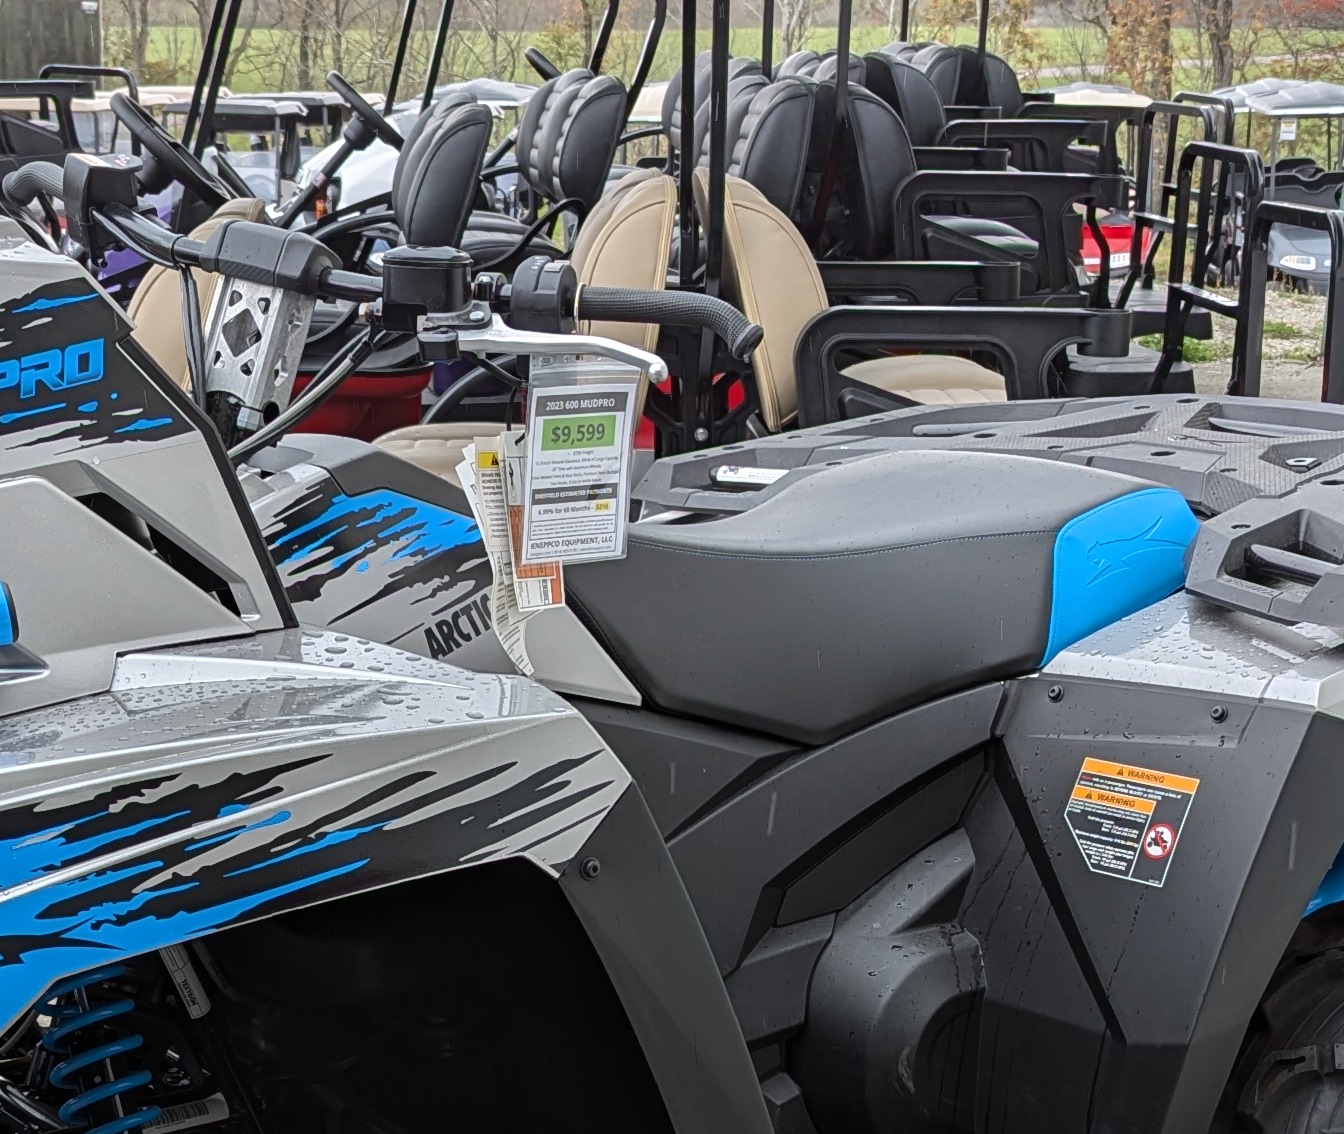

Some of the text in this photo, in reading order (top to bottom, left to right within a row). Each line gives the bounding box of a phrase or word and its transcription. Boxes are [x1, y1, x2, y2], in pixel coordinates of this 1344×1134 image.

[545, 398, 616, 411] 2023 600 MUDPRO
[550, 423, 606, 445] $9,599
[530, 540, 560, 550] KNEPPCO
[601, 535, 613, 543] LLC
[1127, 769, 1166, 784] WARNING
[1097, 792, 1136, 808] WARNING
